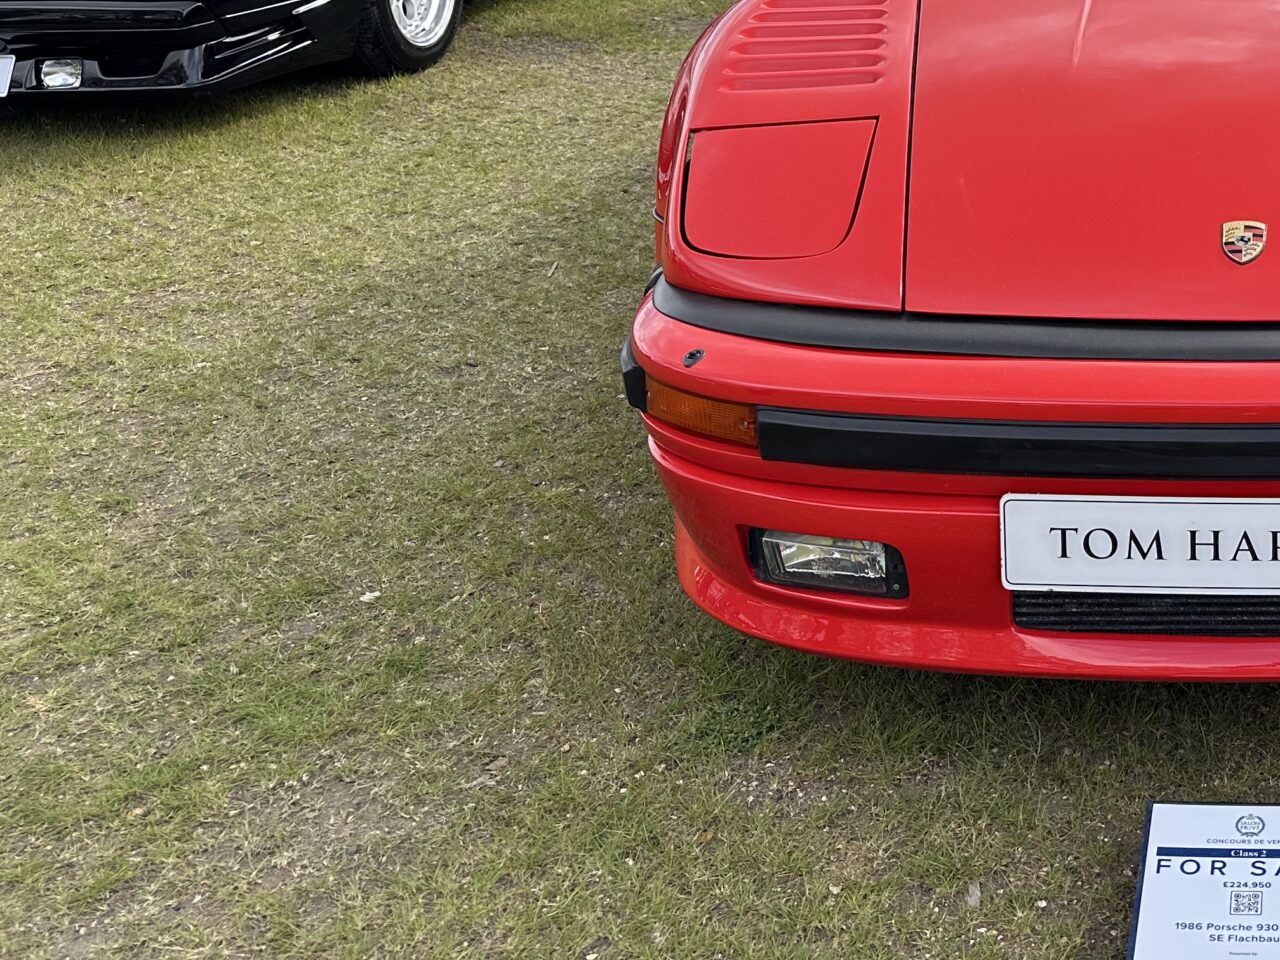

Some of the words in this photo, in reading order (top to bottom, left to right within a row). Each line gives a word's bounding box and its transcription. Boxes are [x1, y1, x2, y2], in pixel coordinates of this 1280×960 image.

[1049, 526, 1167, 561] TOM
[1231, 849, 1259, 857] Class
[1260, 849, 1267, 857] 2
[1156, 858, 1227, 876] FOR
[1223, 881, 1272, 890] £224,950
[1174, 922, 1203, 931] 1986
[1206, 922, 1253, 932] Porsche
[1256, 923, 1279, 932] 930
[1208, 933, 1224, 942] SE
[1227, 933, 1280, 943] Flachbau
